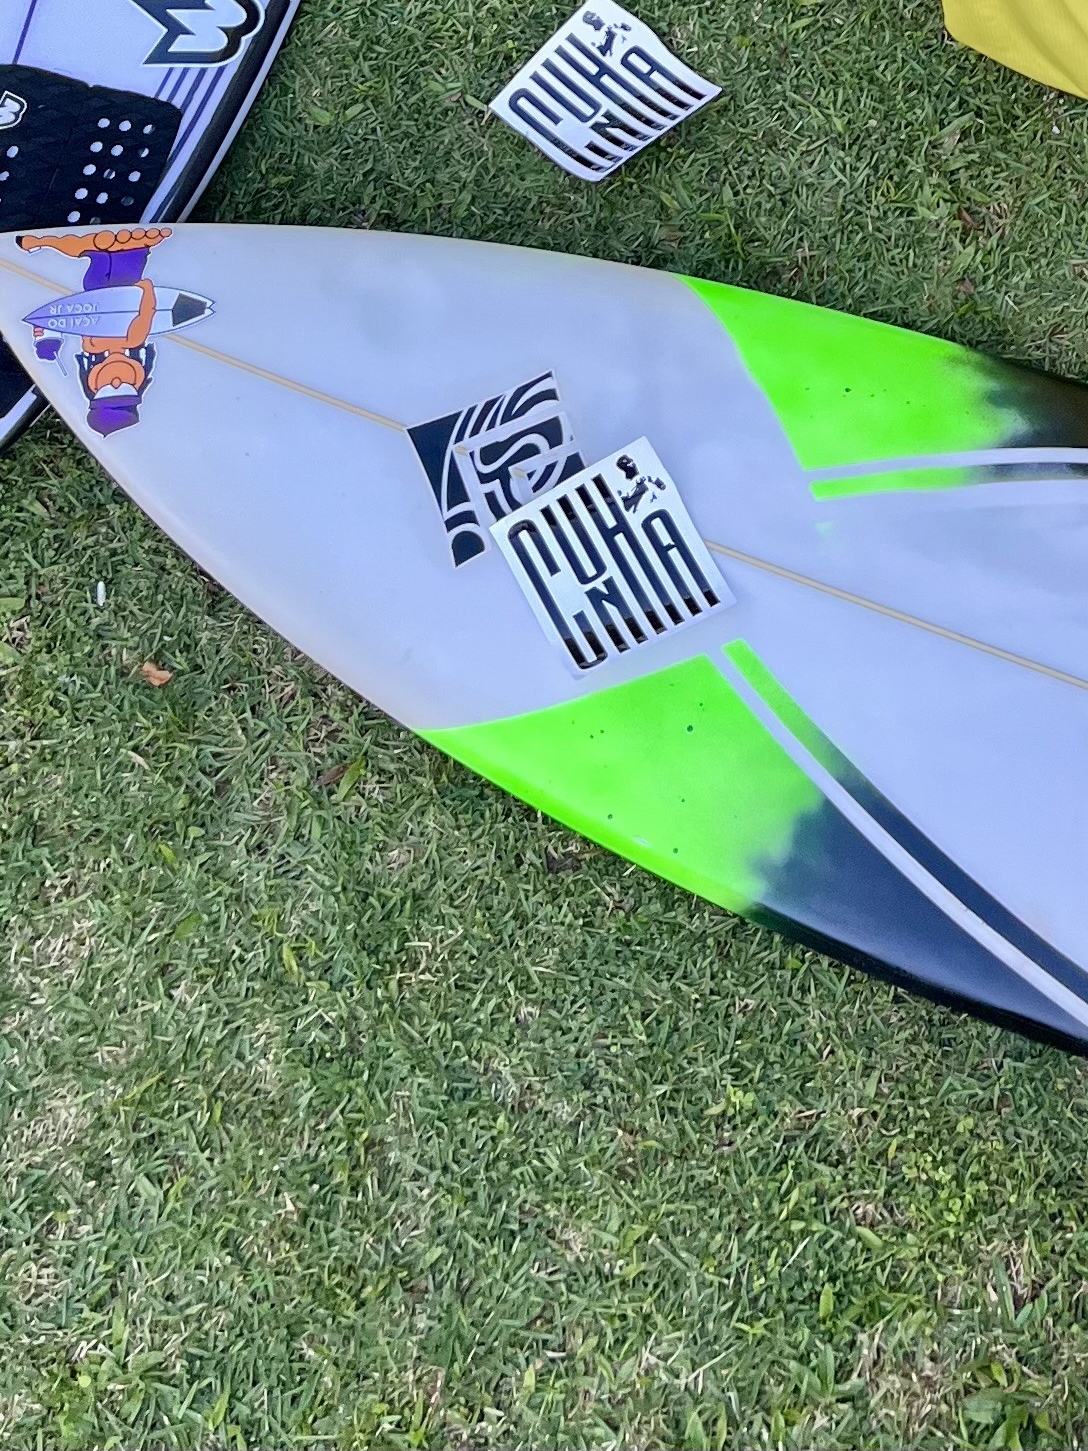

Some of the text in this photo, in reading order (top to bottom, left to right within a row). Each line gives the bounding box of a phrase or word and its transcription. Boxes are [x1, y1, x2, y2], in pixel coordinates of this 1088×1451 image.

[50, 302, 99, 314] JOCA JR
[48, 318, 66, 328] DO
